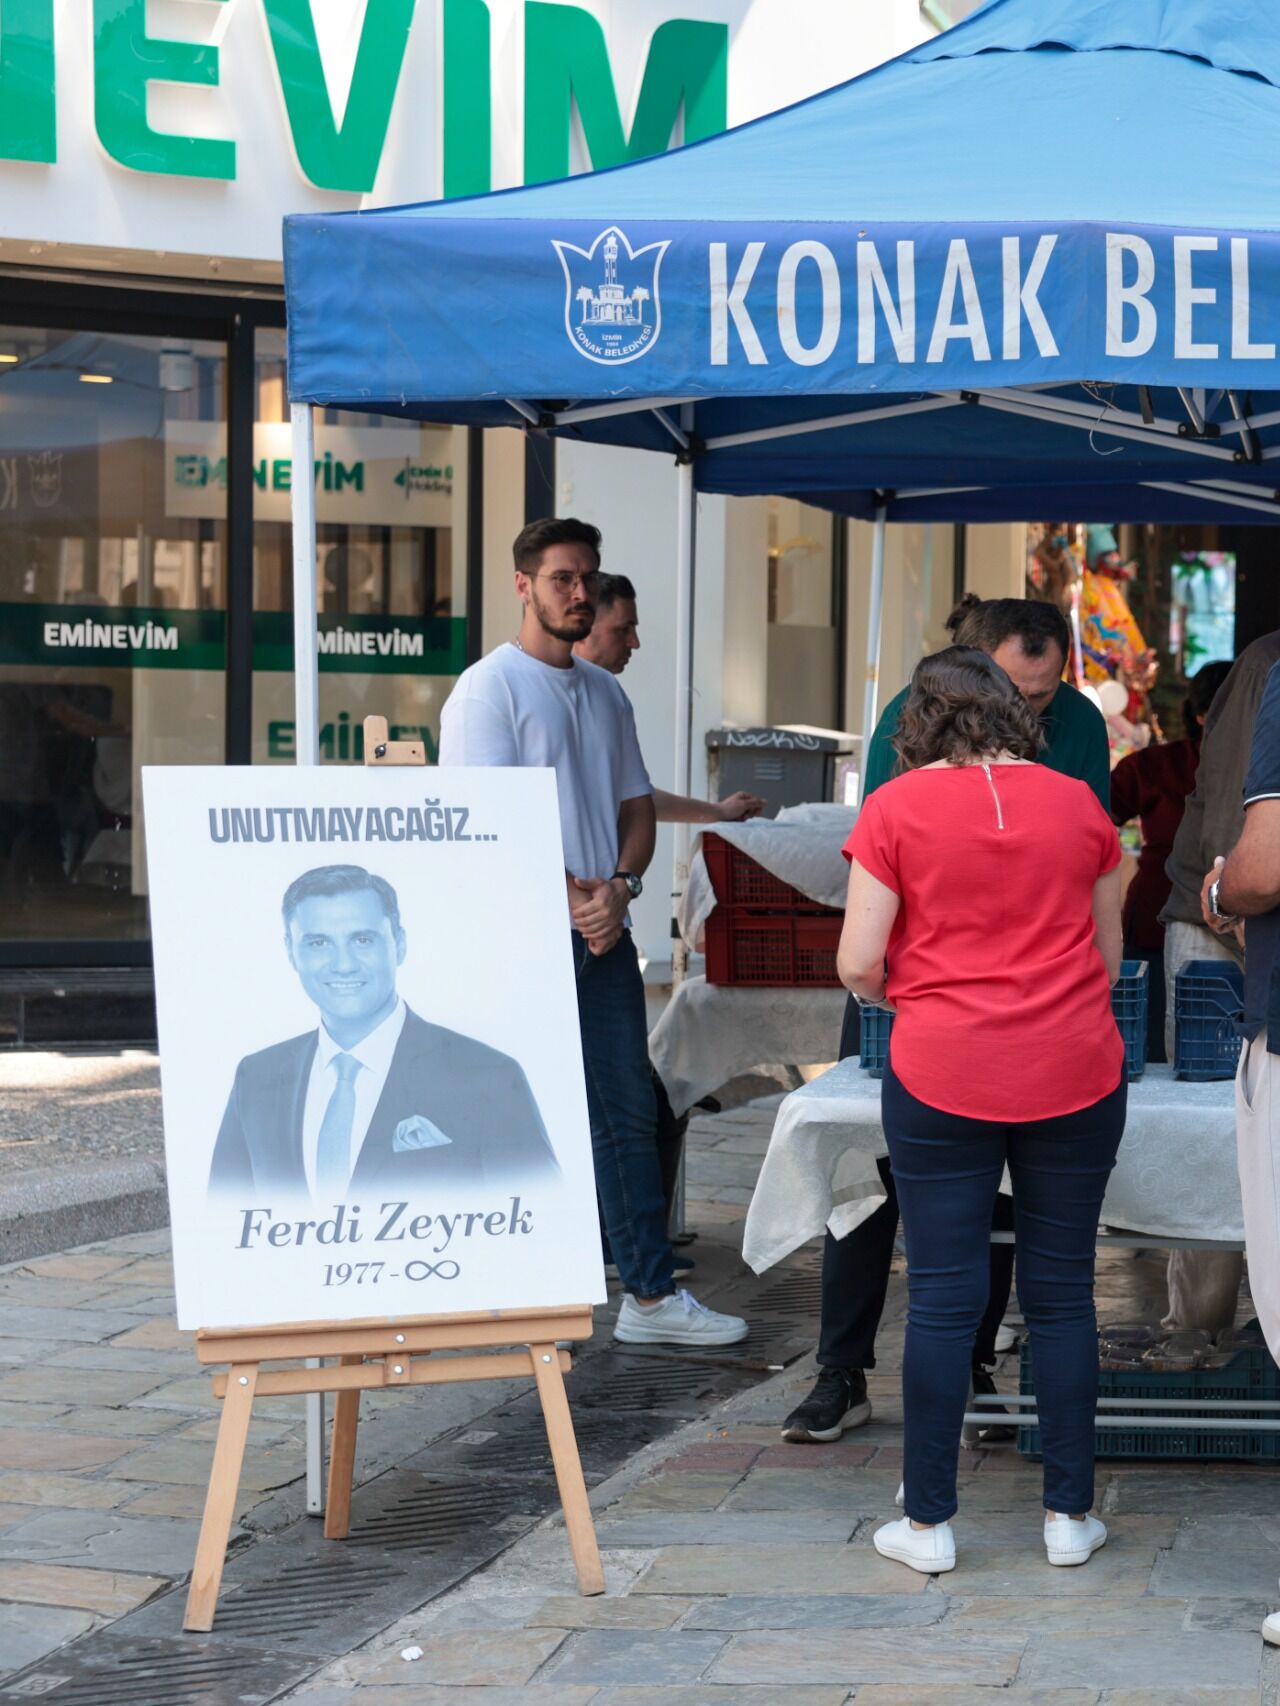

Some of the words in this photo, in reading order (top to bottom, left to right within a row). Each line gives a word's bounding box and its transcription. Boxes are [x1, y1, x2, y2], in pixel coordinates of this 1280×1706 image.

[709, 234, 1060, 366] KONAK
[574, 326, 603, 355] KONAK
[175, 452, 365, 493] EMNEİM
[43, 619, 179, 650] EMİNEVİM
[316, 626, 424, 657] MİNEVİM
[235, 1205, 363, 1249] Ferdi
[374, 1196, 534, 1253] Zeyrek
